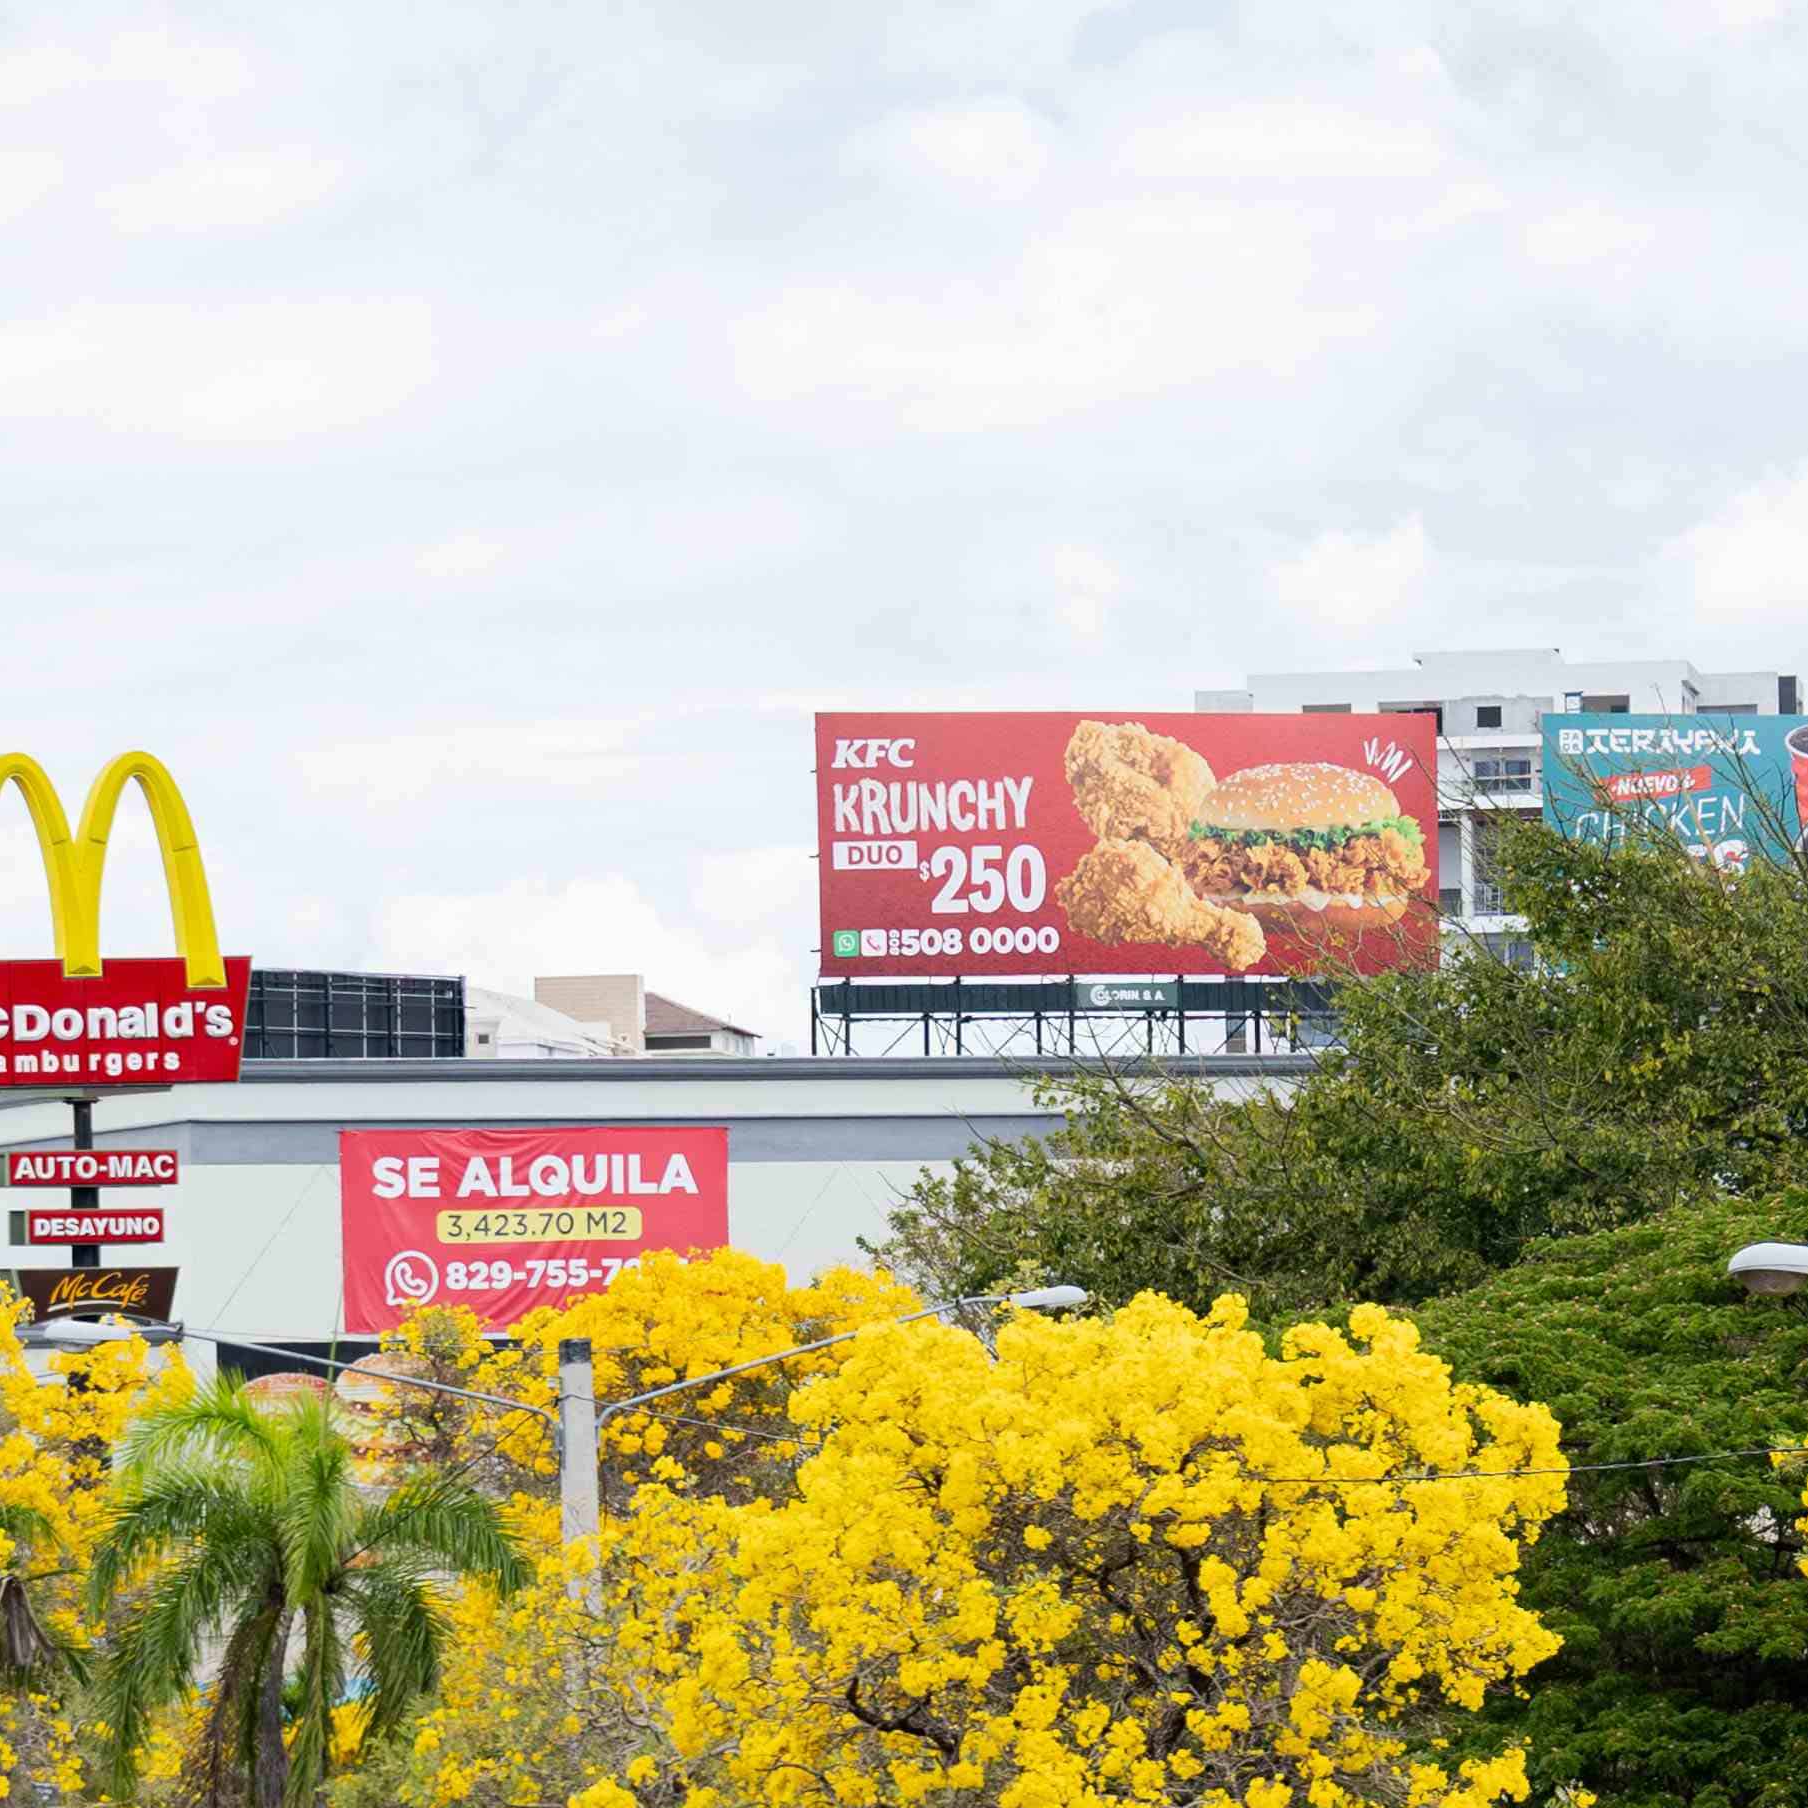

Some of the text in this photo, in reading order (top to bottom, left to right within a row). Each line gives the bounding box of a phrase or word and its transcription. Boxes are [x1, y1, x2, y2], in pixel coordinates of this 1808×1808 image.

[831, 738, 916, 768] KFC
[832, 776, 1034, 835] KRUNCHY
[847, 845, 903, 866] DUO
[901, 928, 963, 956] 508
[969, 926, 1060, 955] 0000
[15, 1155, 174, 1180] AUTO-MAC
[372, 1153, 699, 1198] SE ALQUILA
[34, 1217, 160, 1237] DESAYUNO
[447, 1210, 628, 1241] 3,423.70 M2
[445, 1257, 689, 1290] 829-755-7
[49, 1271, 151, 1309] McCafé
